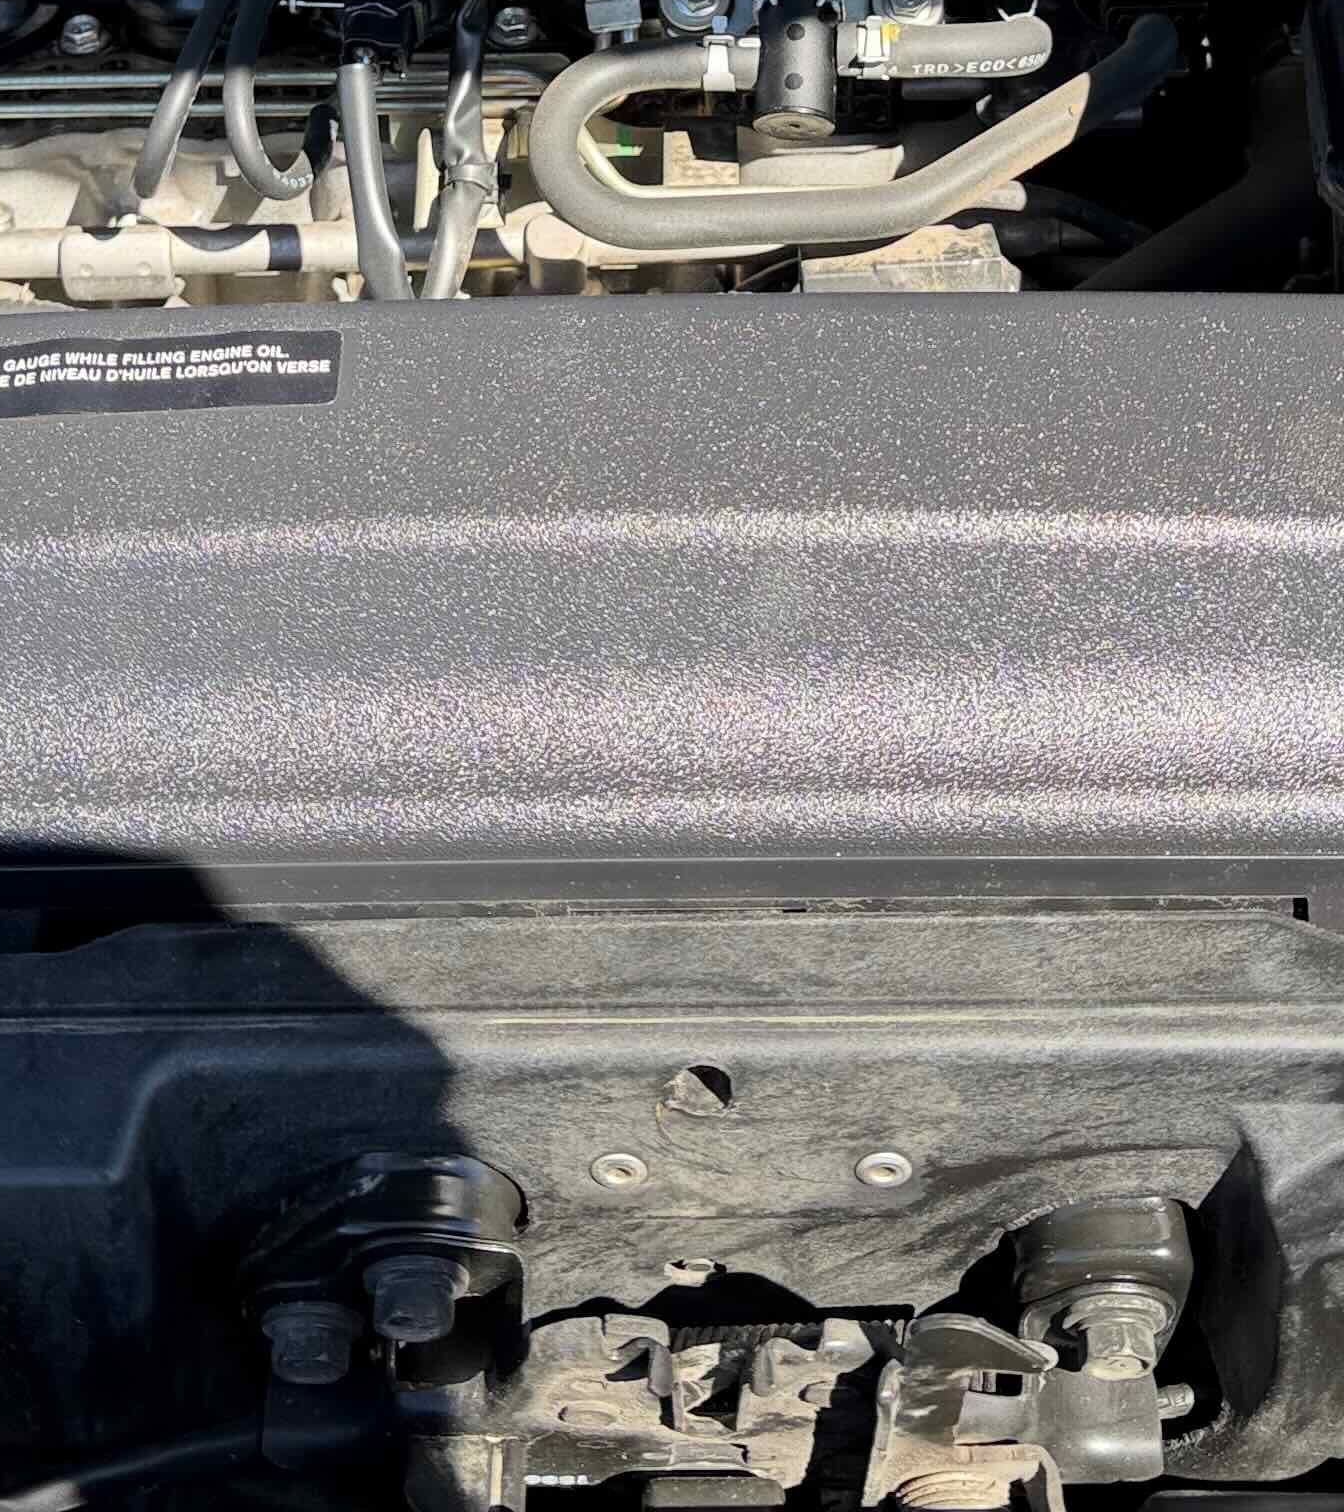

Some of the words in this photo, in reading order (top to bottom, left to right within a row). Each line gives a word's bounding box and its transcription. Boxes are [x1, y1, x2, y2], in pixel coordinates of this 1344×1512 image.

[3, 353, 61, 372] GAUGE
[65, 352, 118, 366] WHILE
[122, 351, 186, 366] FILLING
[190, 345, 253, 362] ENGINE
[257, 344, 289, 359] OIL.
[14, 372, 37, 387] DE
[40, 368, 102, 383] NIVEAU
[106, 367, 172, 382] D'HUILE
[176, 360, 273, 379] LORSQU'ON
[276, 359, 332, 374] VERSE
